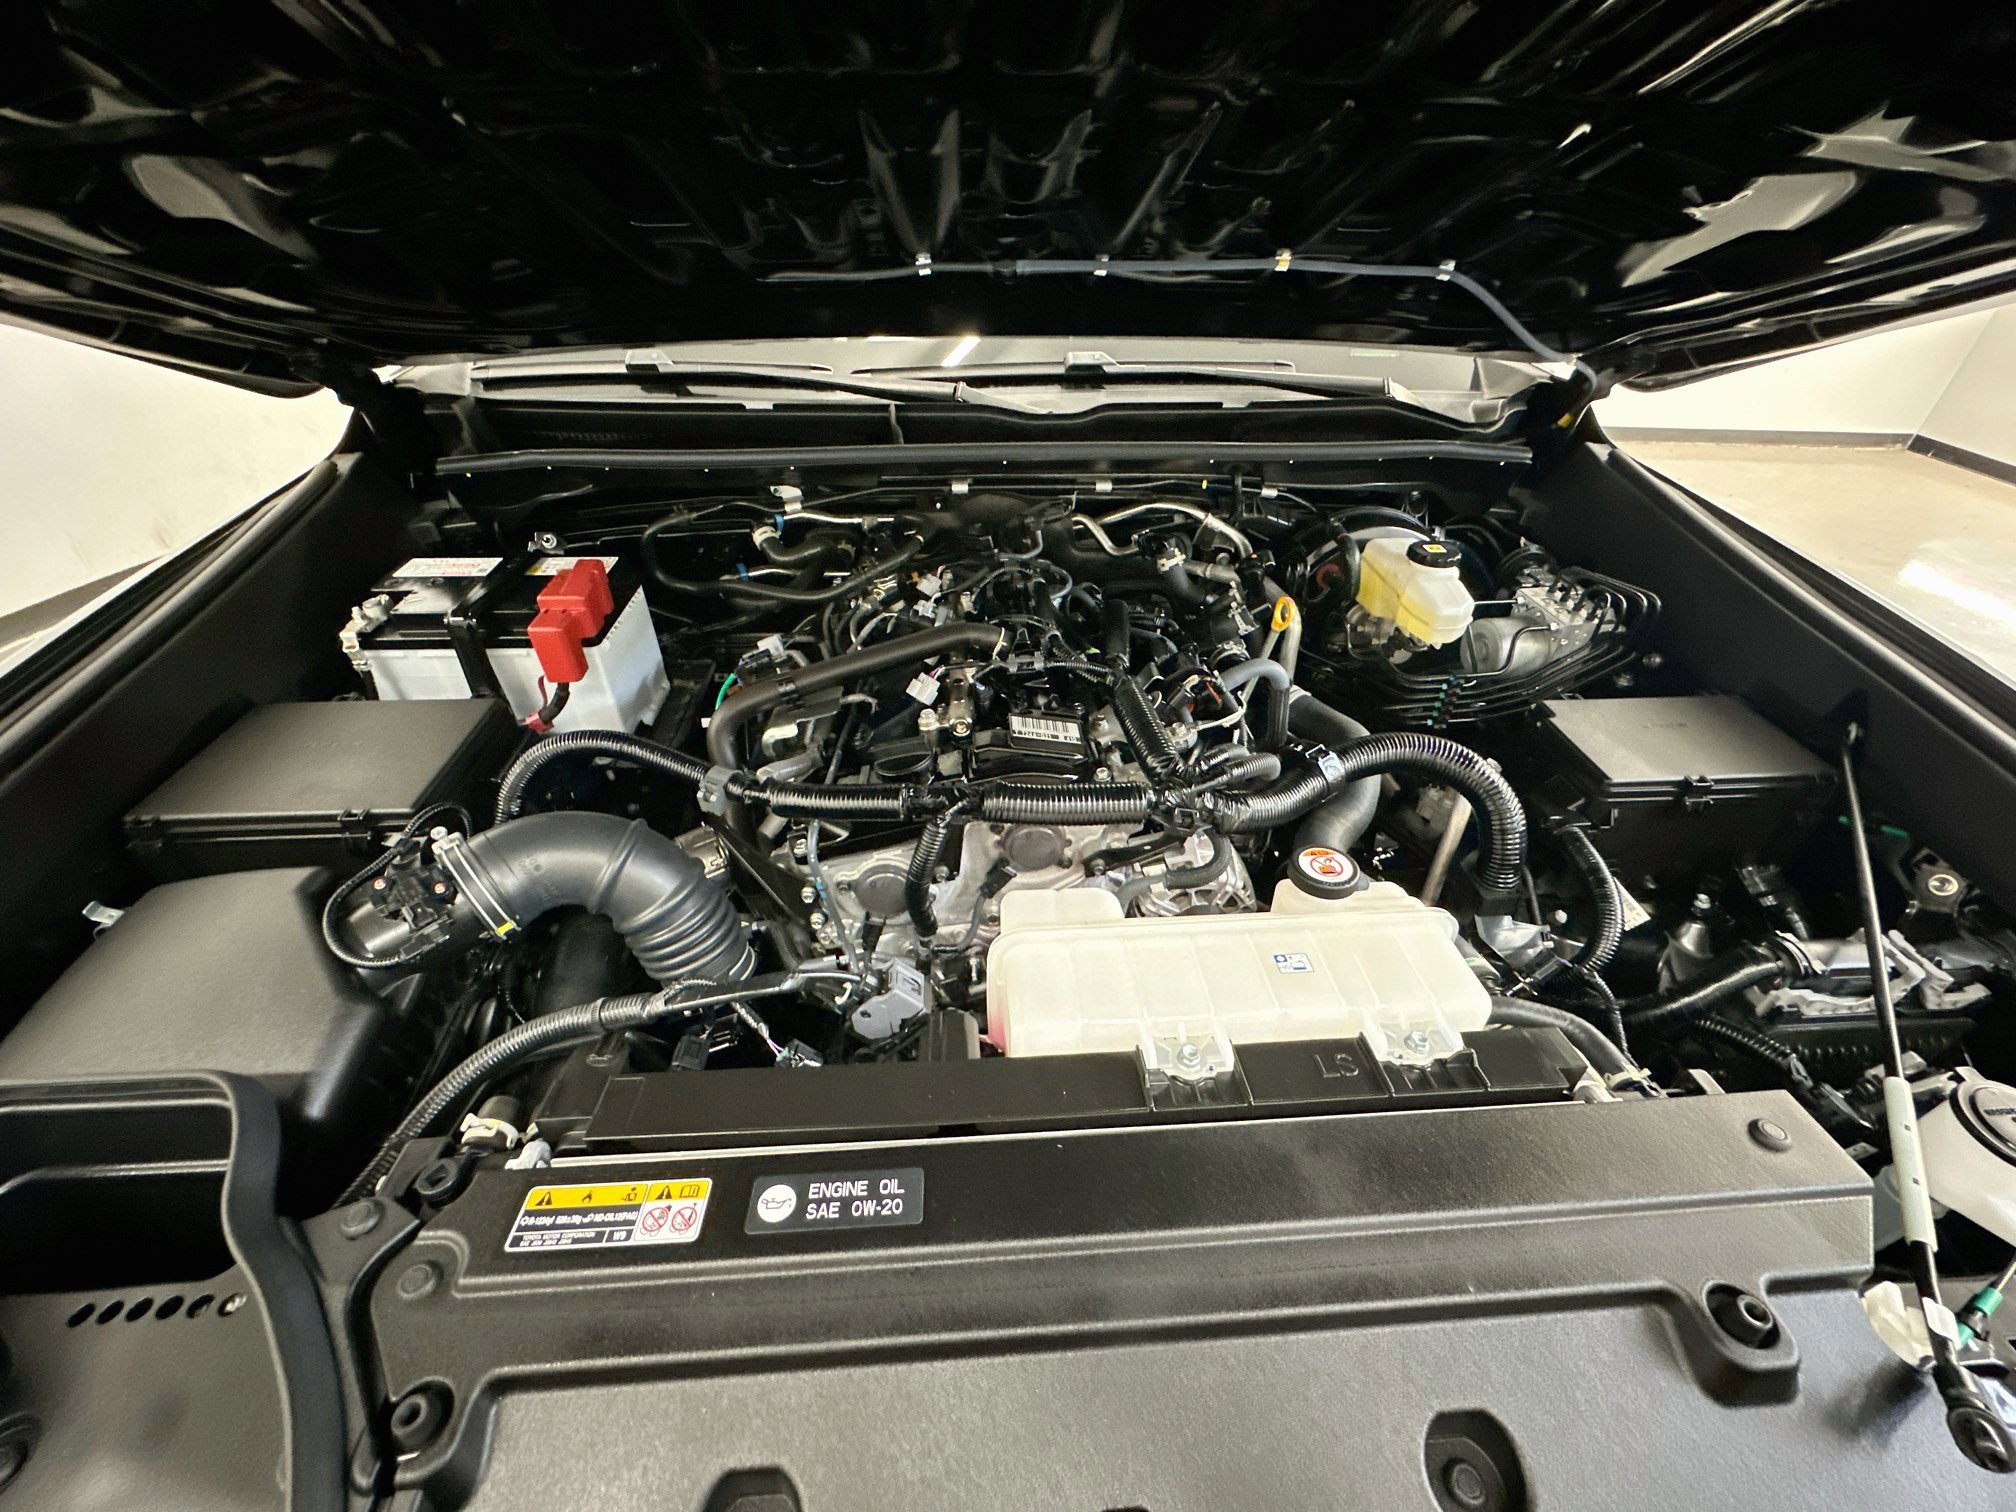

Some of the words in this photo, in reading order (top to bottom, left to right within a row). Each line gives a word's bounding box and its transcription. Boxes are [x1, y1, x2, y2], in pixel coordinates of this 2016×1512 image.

[1313, 1053, 1359, 1078] LS
[808, 1180, 869, 1199] ENGINE
[879, 1178, 905, 1195] OIL
[805, 1202, 841, 1220] SAE
[851, 1199, 903, 1217] 0W-20
[613, 1231, 627, 1241] W9
